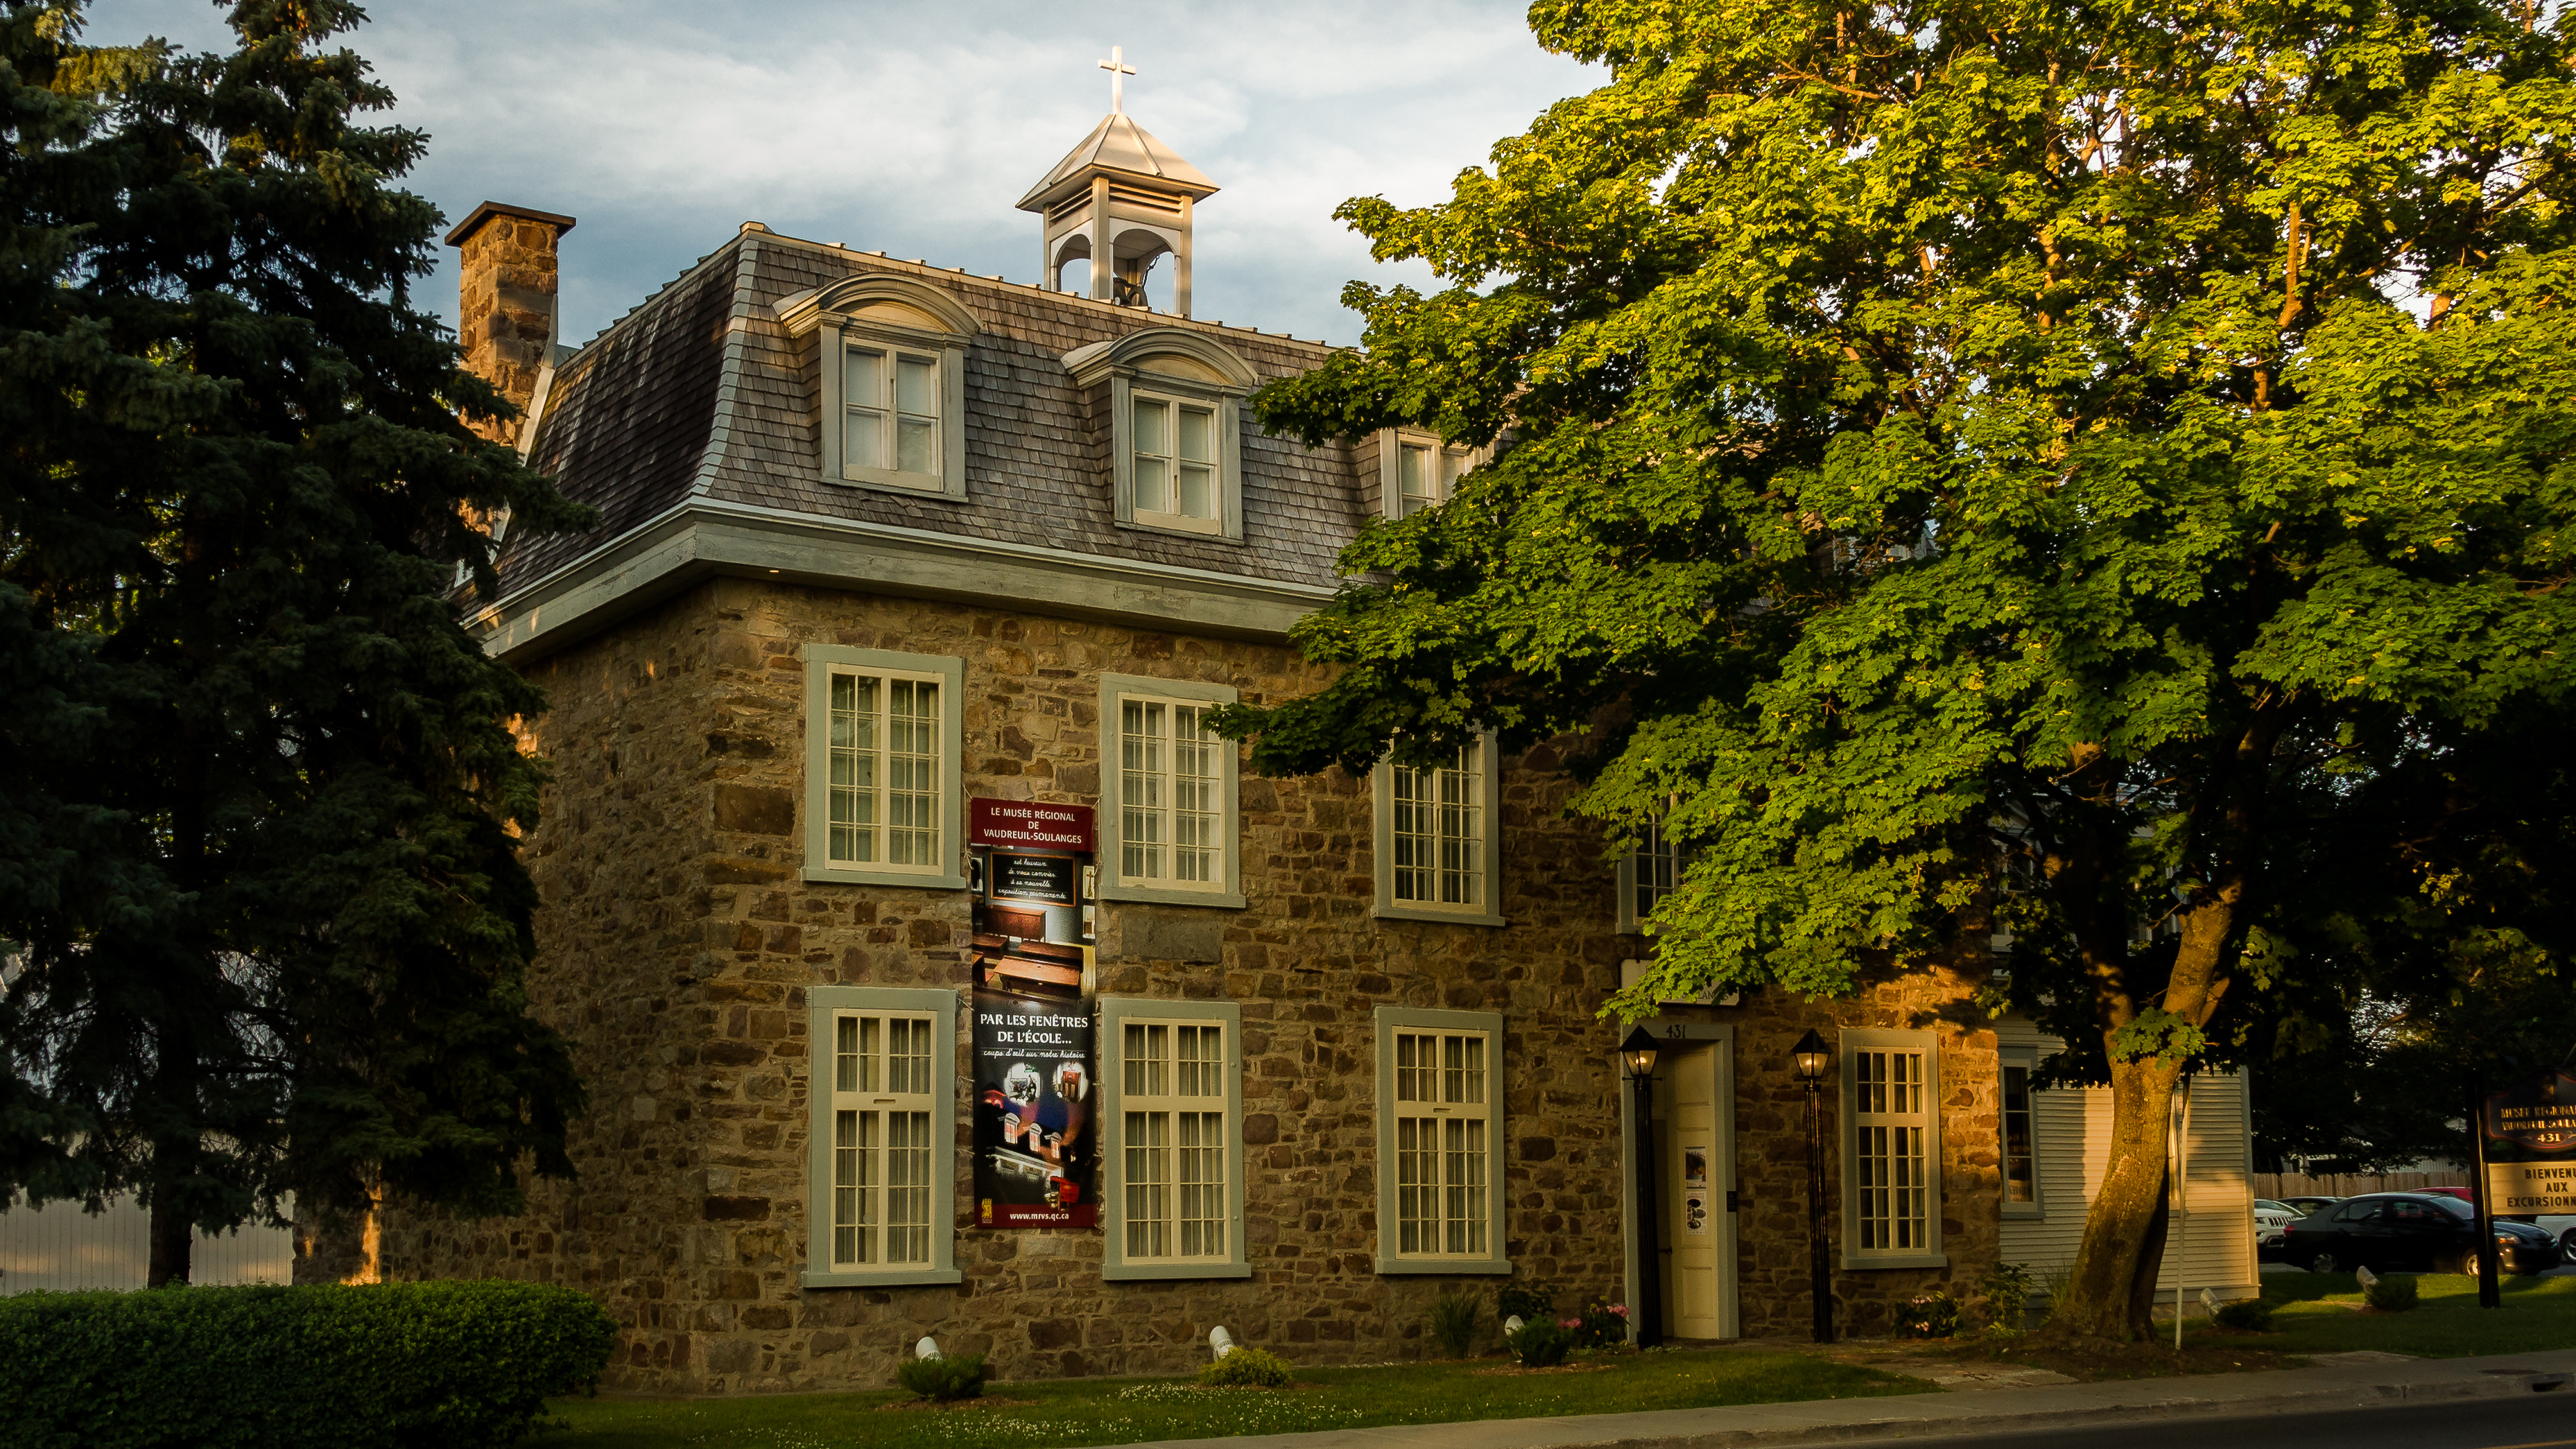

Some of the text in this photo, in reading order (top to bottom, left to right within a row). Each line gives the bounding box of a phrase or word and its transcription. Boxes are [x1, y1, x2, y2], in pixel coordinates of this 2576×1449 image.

[991, 808, 1075, 822] LE MUSÉE RÉGIONAL
[1028, 821, 1039, 830] DE
[984, 828, 1082, 844] VAUDREUIL-SOULANGES
[1023, 858, 1047, 867] heureux
[1029, 891, 1066, 899] permanente
[980, 1014, 1088, 1028] PAR LES FENÊTRES
[1666, 1024, 1686, 1039] 431
[997, 1031, 1014, 1043] DE
[983, 1050, 1003, 1059] coups
[1060, 1050, 1085, 1059] histoire
[2536, 1133, 2561, 1143] 431
[2545, 1182, 2568, 1193] AUX
[1010, 1213, 1069, 1221] www.mrvs.qc.ca
